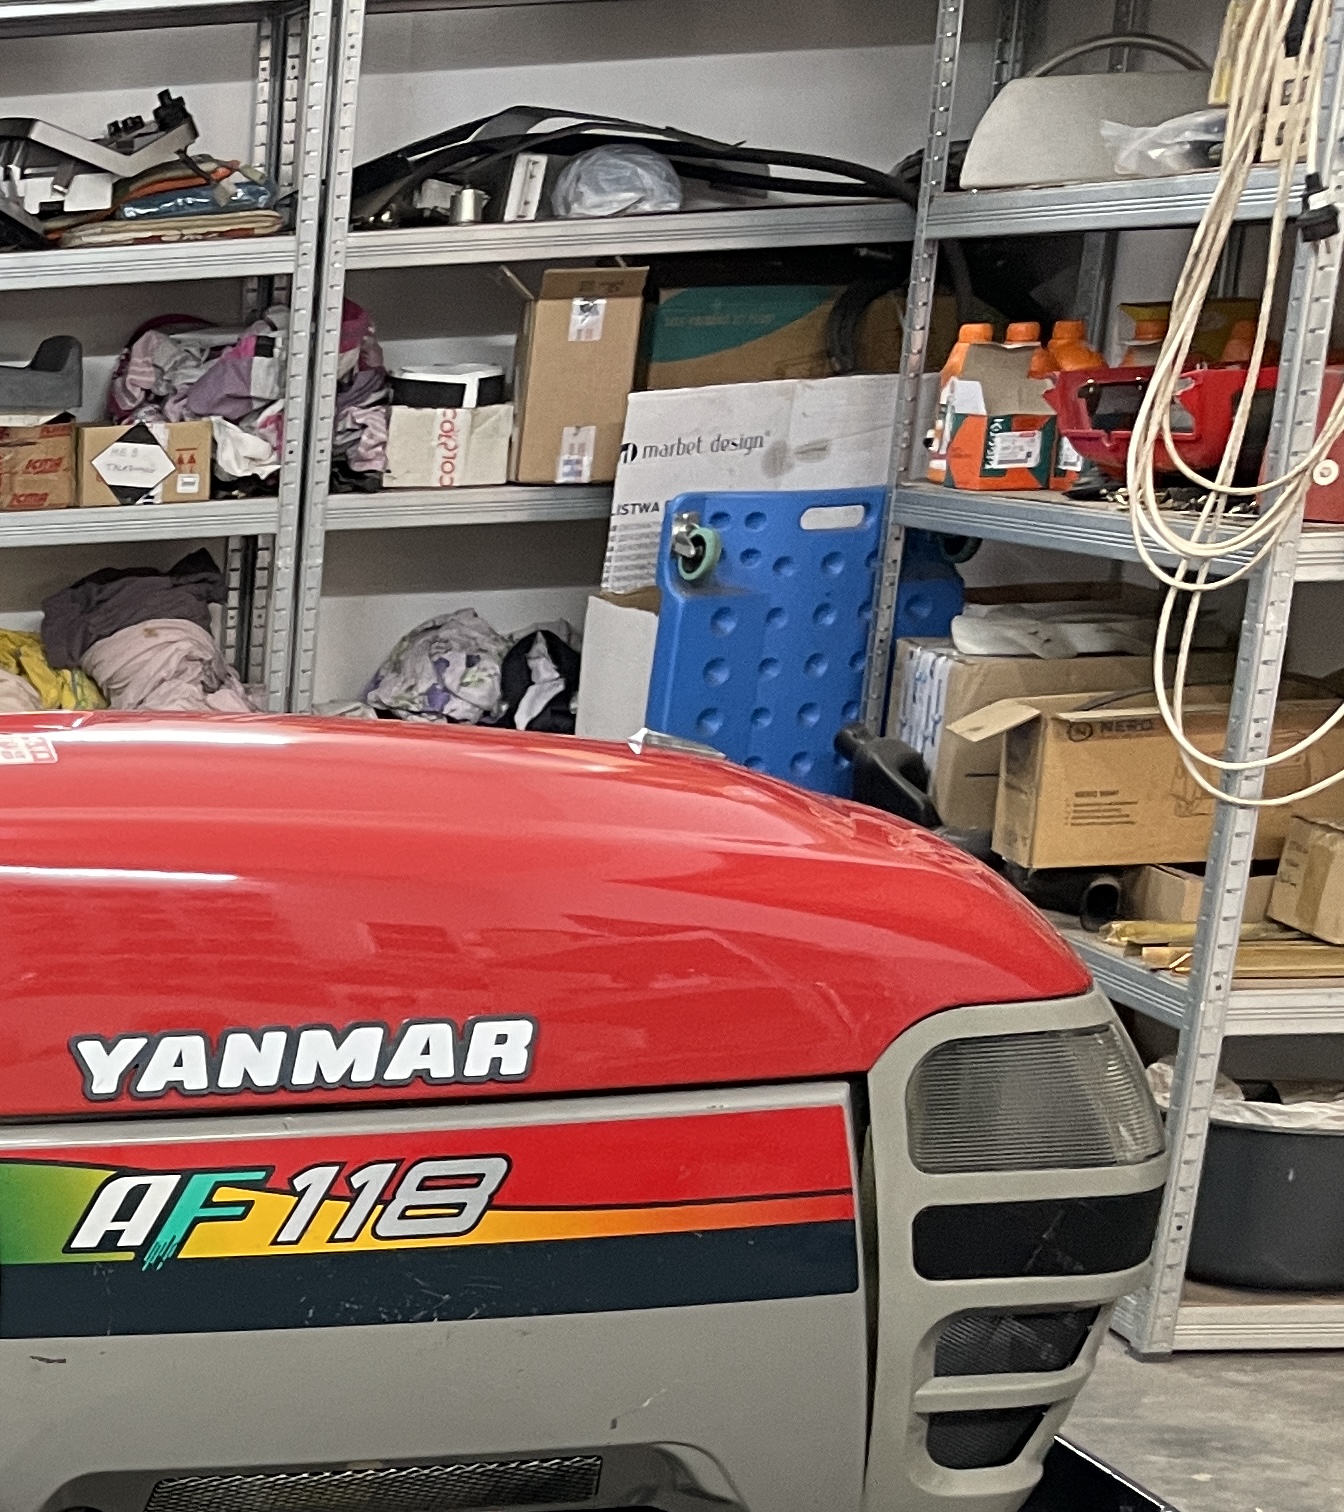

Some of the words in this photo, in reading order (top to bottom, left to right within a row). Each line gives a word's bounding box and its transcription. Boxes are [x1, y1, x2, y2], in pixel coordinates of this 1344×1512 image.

[641, 436, 703, 460] marbet
[711, 432, 765, 456] design
[75, 1018, 535, 1096] YANMAR
